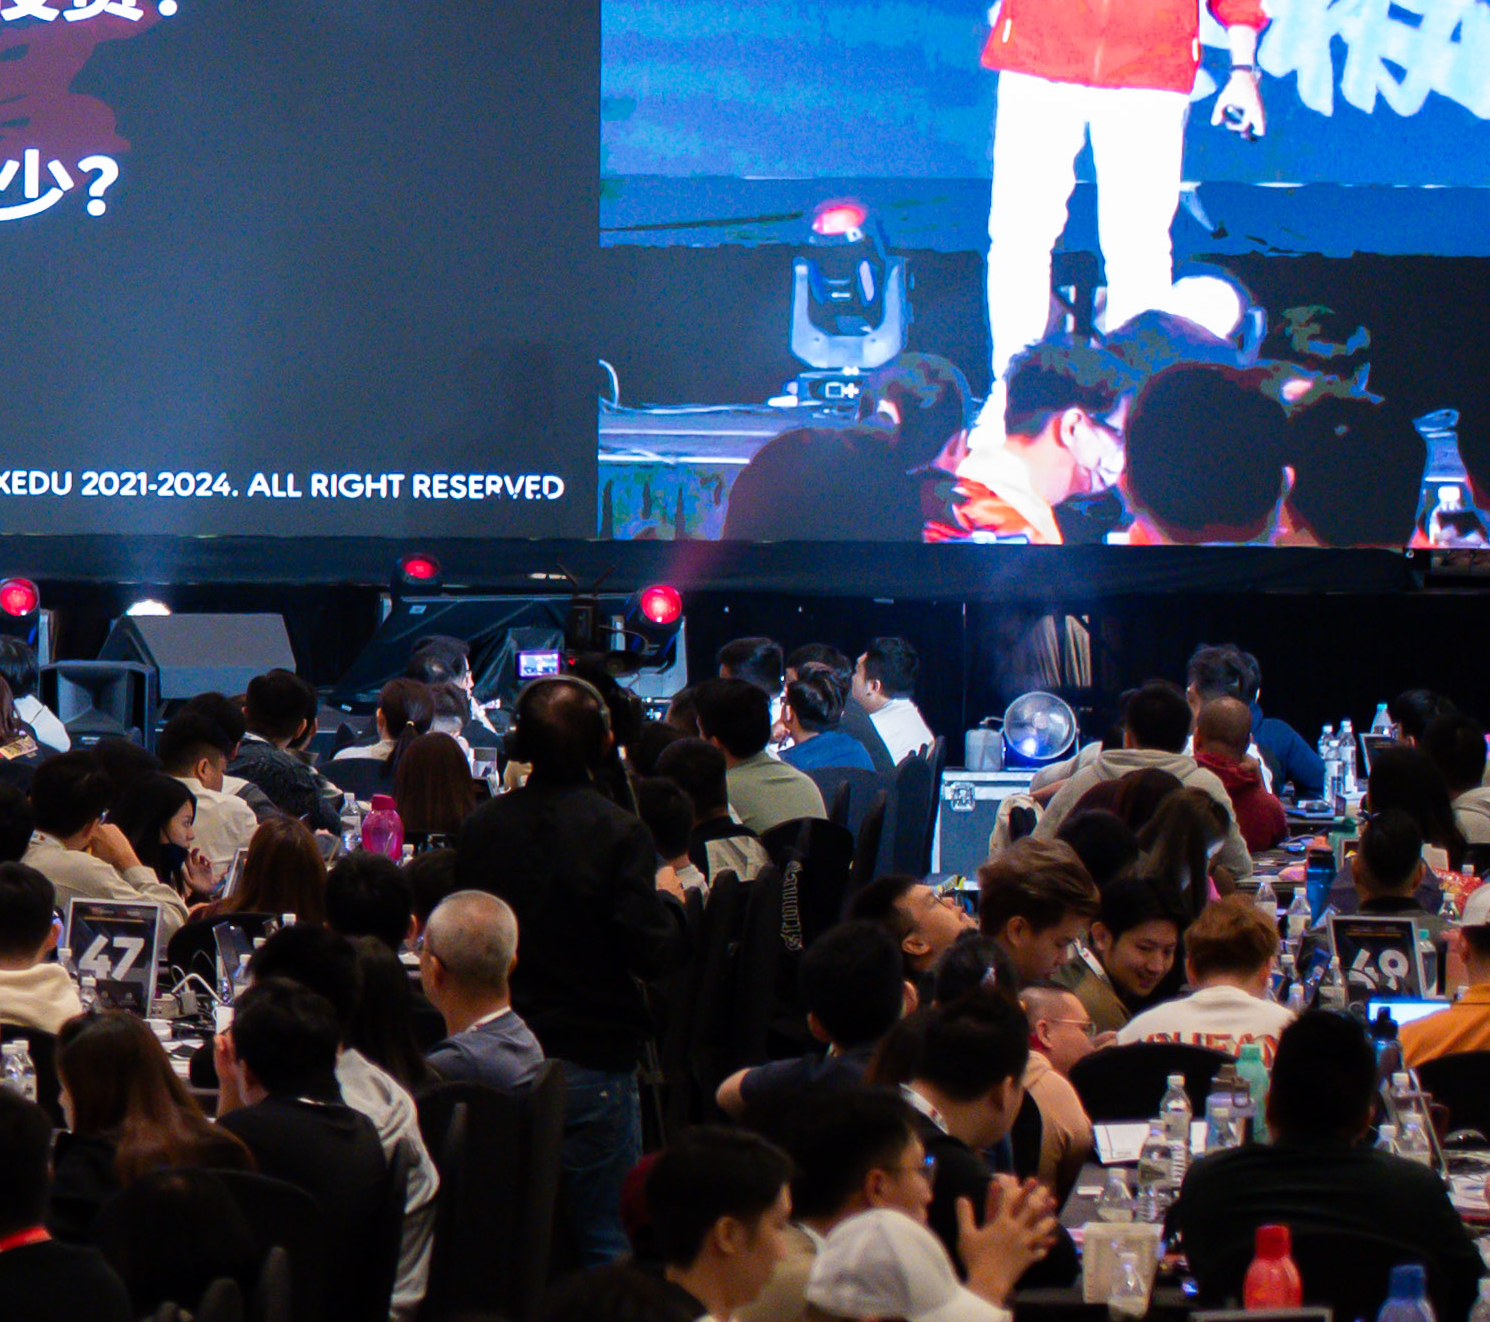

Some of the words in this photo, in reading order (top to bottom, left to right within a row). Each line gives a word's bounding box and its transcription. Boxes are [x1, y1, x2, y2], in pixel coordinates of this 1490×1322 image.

[81, 471, 239, 498] 2021-2024.
[247, 473, 302, 498] ALL
[310, 474, 405, 500] RIGHT
[413, 475, 565, 500] RESERVED
[78, 933, 145, 982] 47
